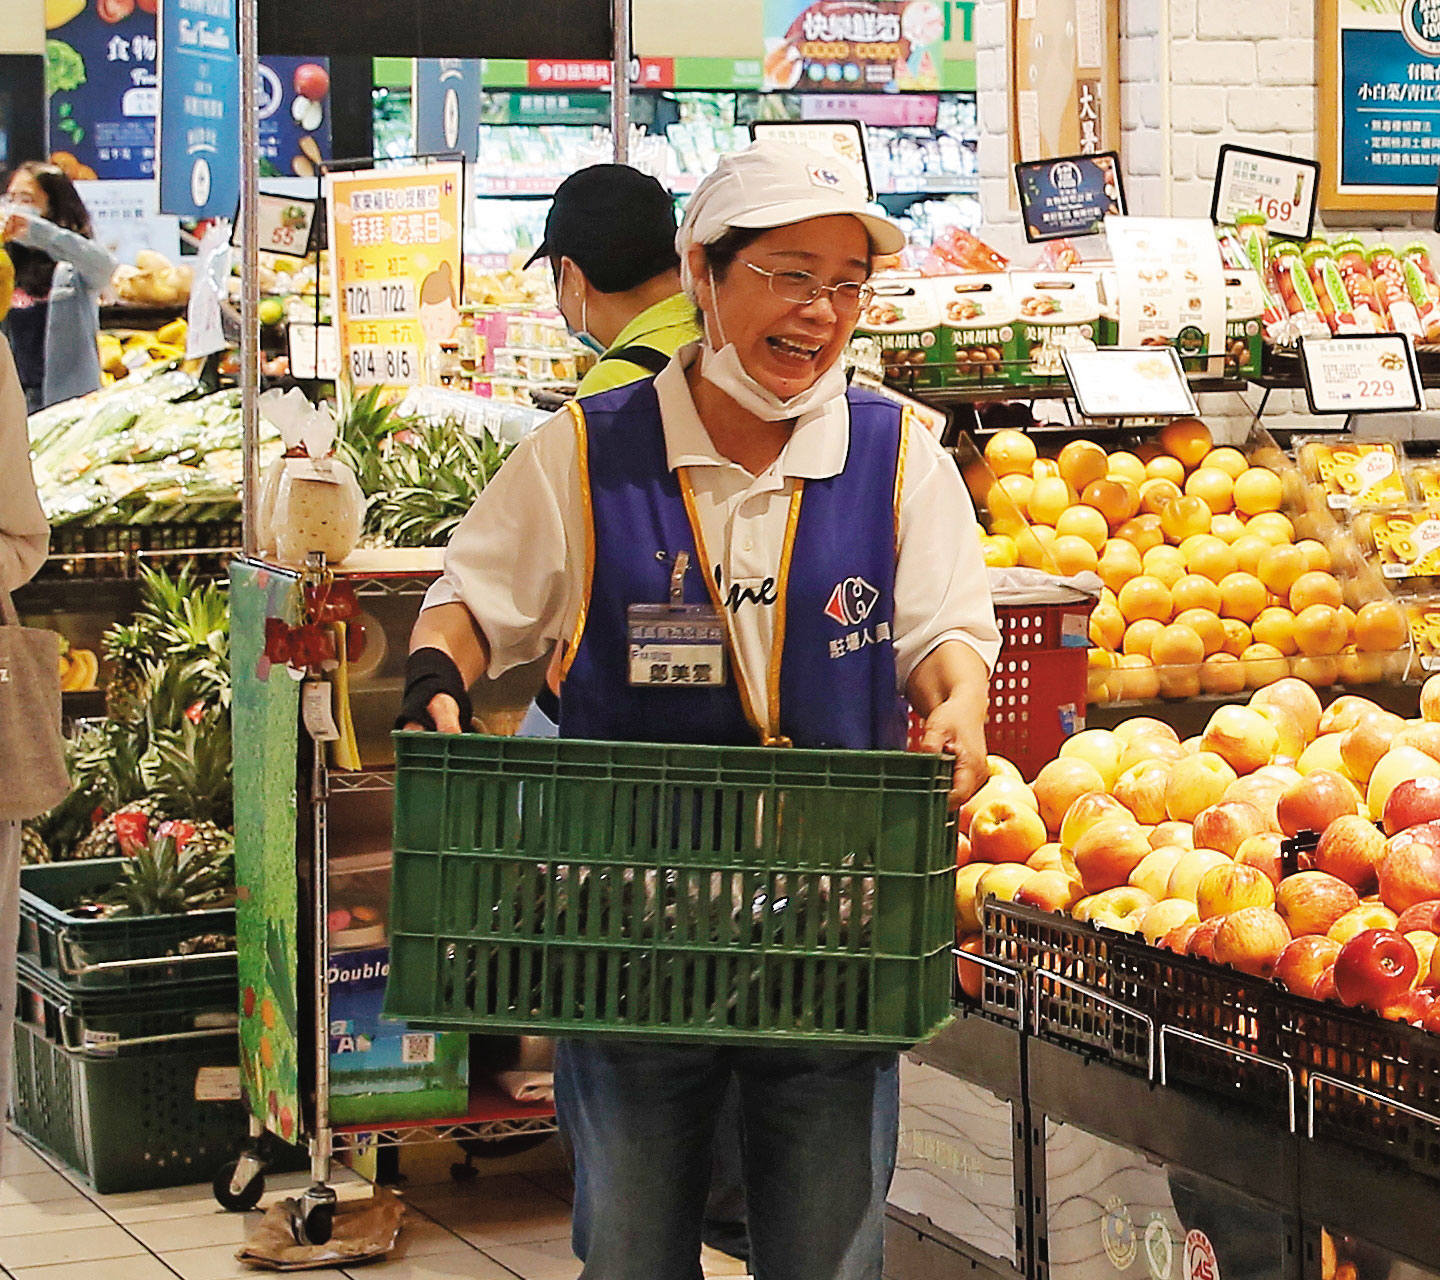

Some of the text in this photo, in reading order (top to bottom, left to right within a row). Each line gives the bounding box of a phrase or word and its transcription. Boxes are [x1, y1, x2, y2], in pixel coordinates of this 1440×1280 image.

[802, 12, 901, 43] 快樂鮮筍
[108, 35, 157, 62] 食物
[1254, 196, 1292, 222] 169
[272, 227, 295, 246] 55
[348, 284, 406, 314] 7/21 7/22
[358, 325, 412, 343] 十五 十六
[951, 329, 998, 347] 美國胡桃
[353, 351, 410, 377] 8/4 8/5
[1358, 380, 1396, 399] 229
